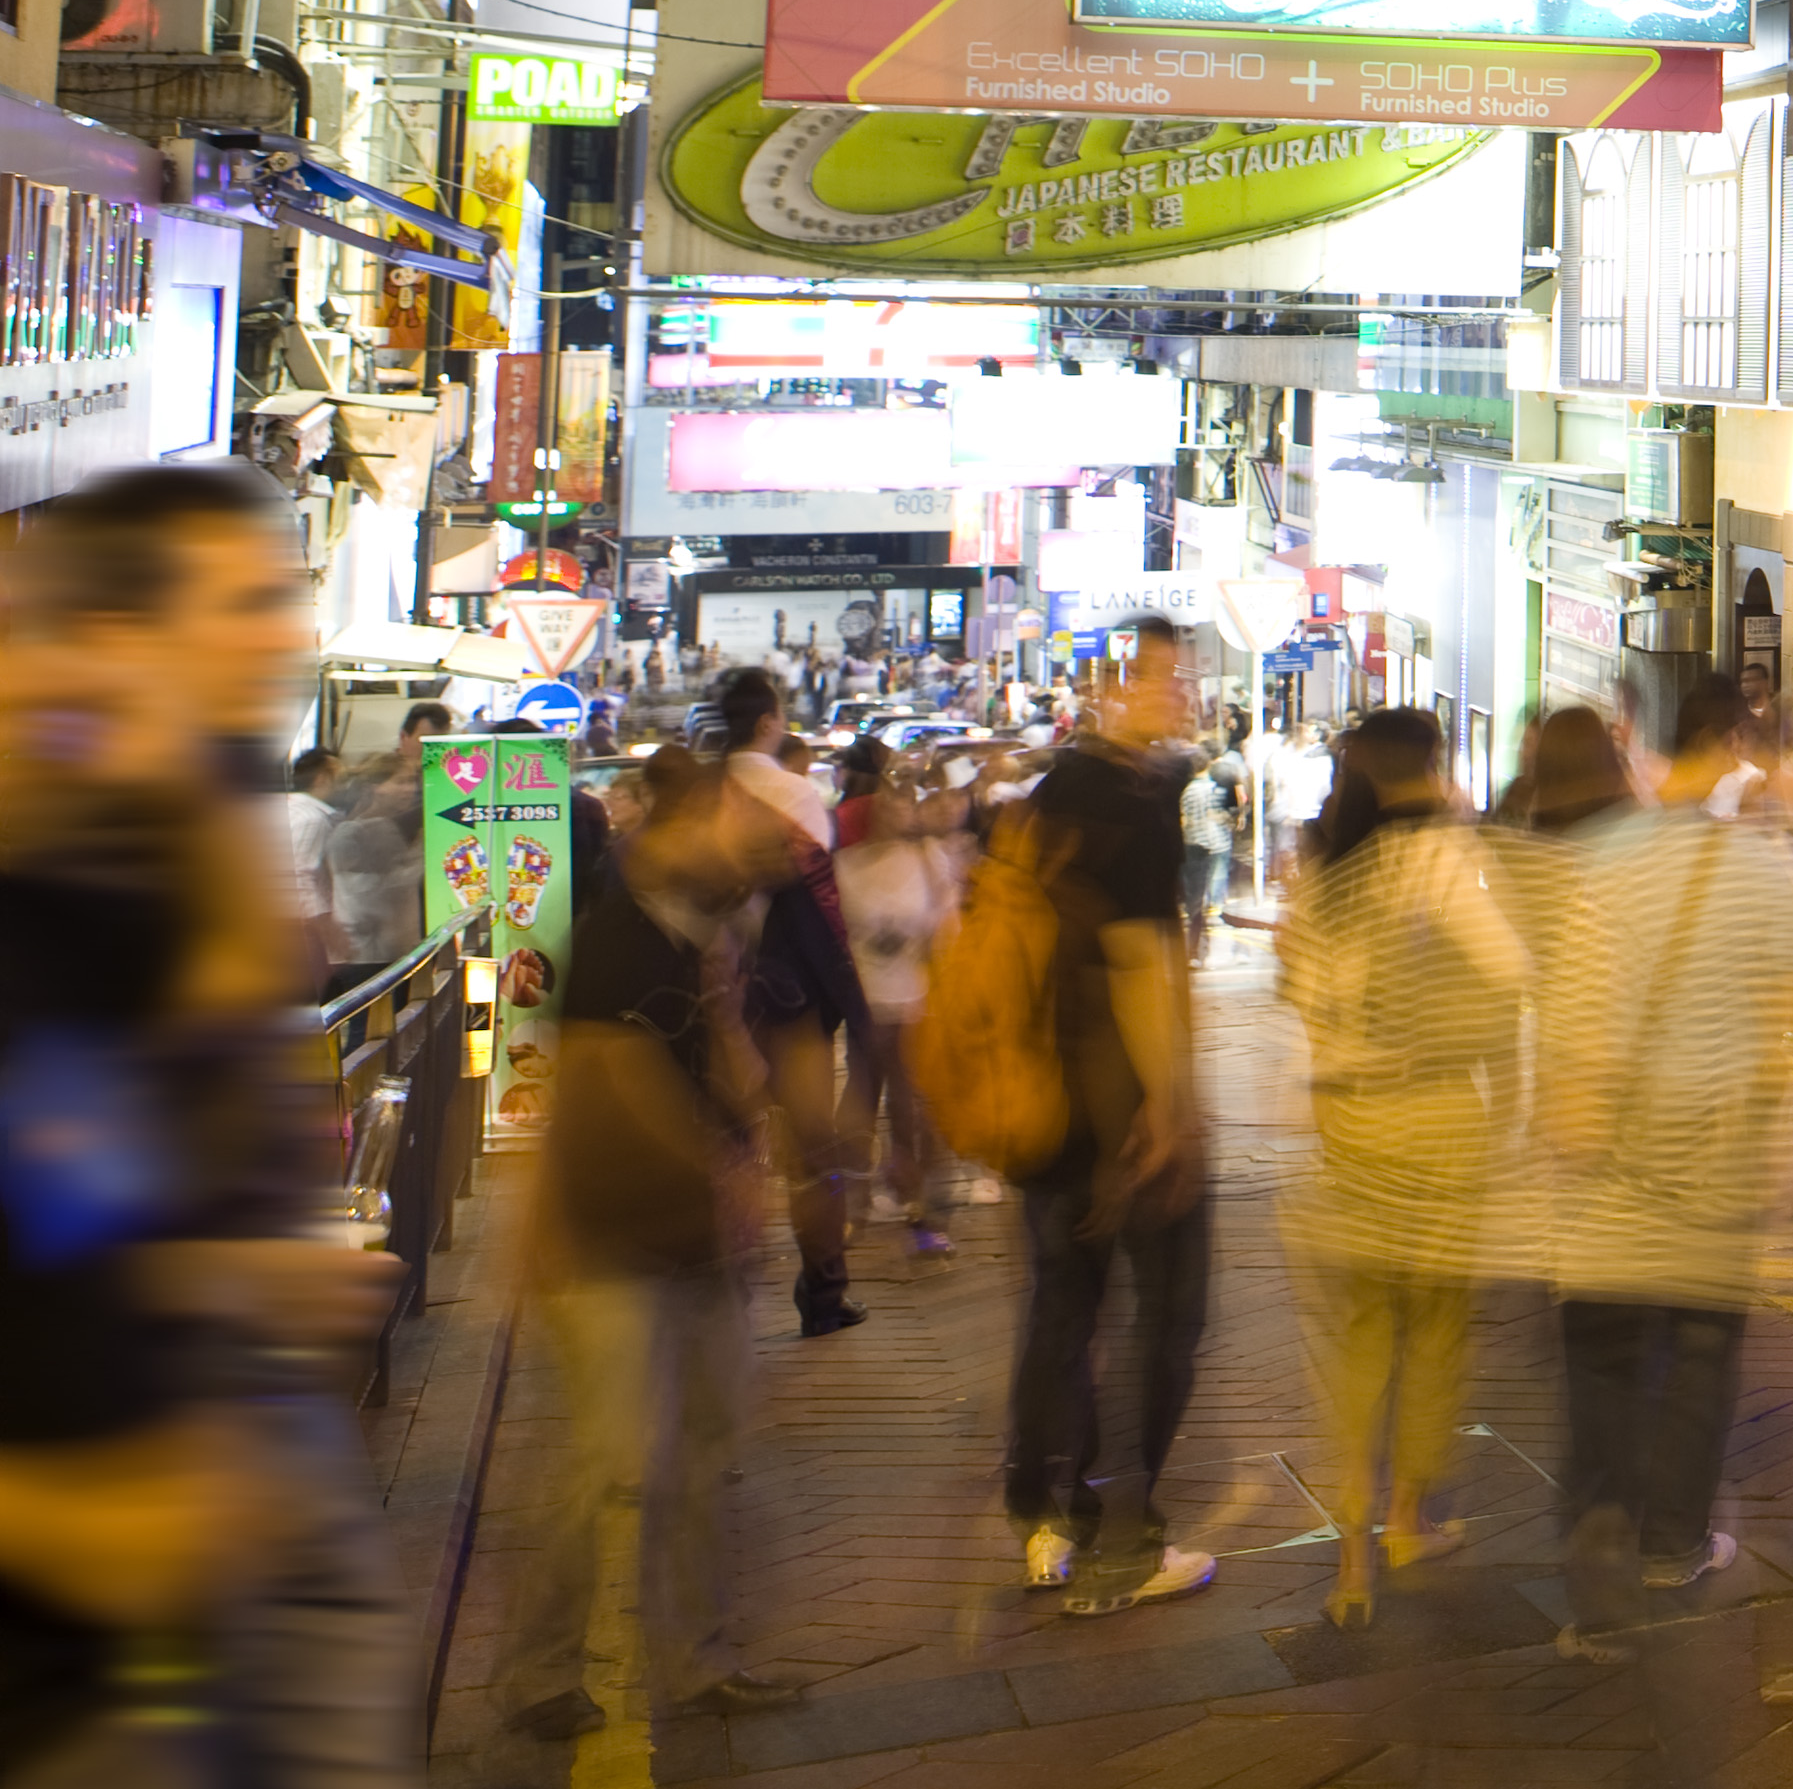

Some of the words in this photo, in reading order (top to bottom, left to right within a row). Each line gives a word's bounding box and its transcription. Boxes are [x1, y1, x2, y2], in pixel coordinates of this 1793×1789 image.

[475, 58, 617, 109] POAD
[967, 41, 1143, 75] Excellent
[1154, 49, 1265, 80] SOHO
[1360, 61, 1473, 93] SOHO
[1485, 66, 1567, 97] Plus
[966, 76, 1087, 102] Furnished
[1093, 80, 1171, 105] Studio
[1361, 92, 1471, 115] Furnished
[1478, 97, 1550, 118] Studio
[997, 161, 1157, 218] JAPANESE
[1165, 128, 1370, 188] RESTAURANT
[1005, 193, 1185, 256] 日本料理
[752, 554, 810, 567] VACHERON
[538, 609, 574, 621] GIVE
[539, 623, 570, 633] WAY
[511, 805, 558, 820] 3098
